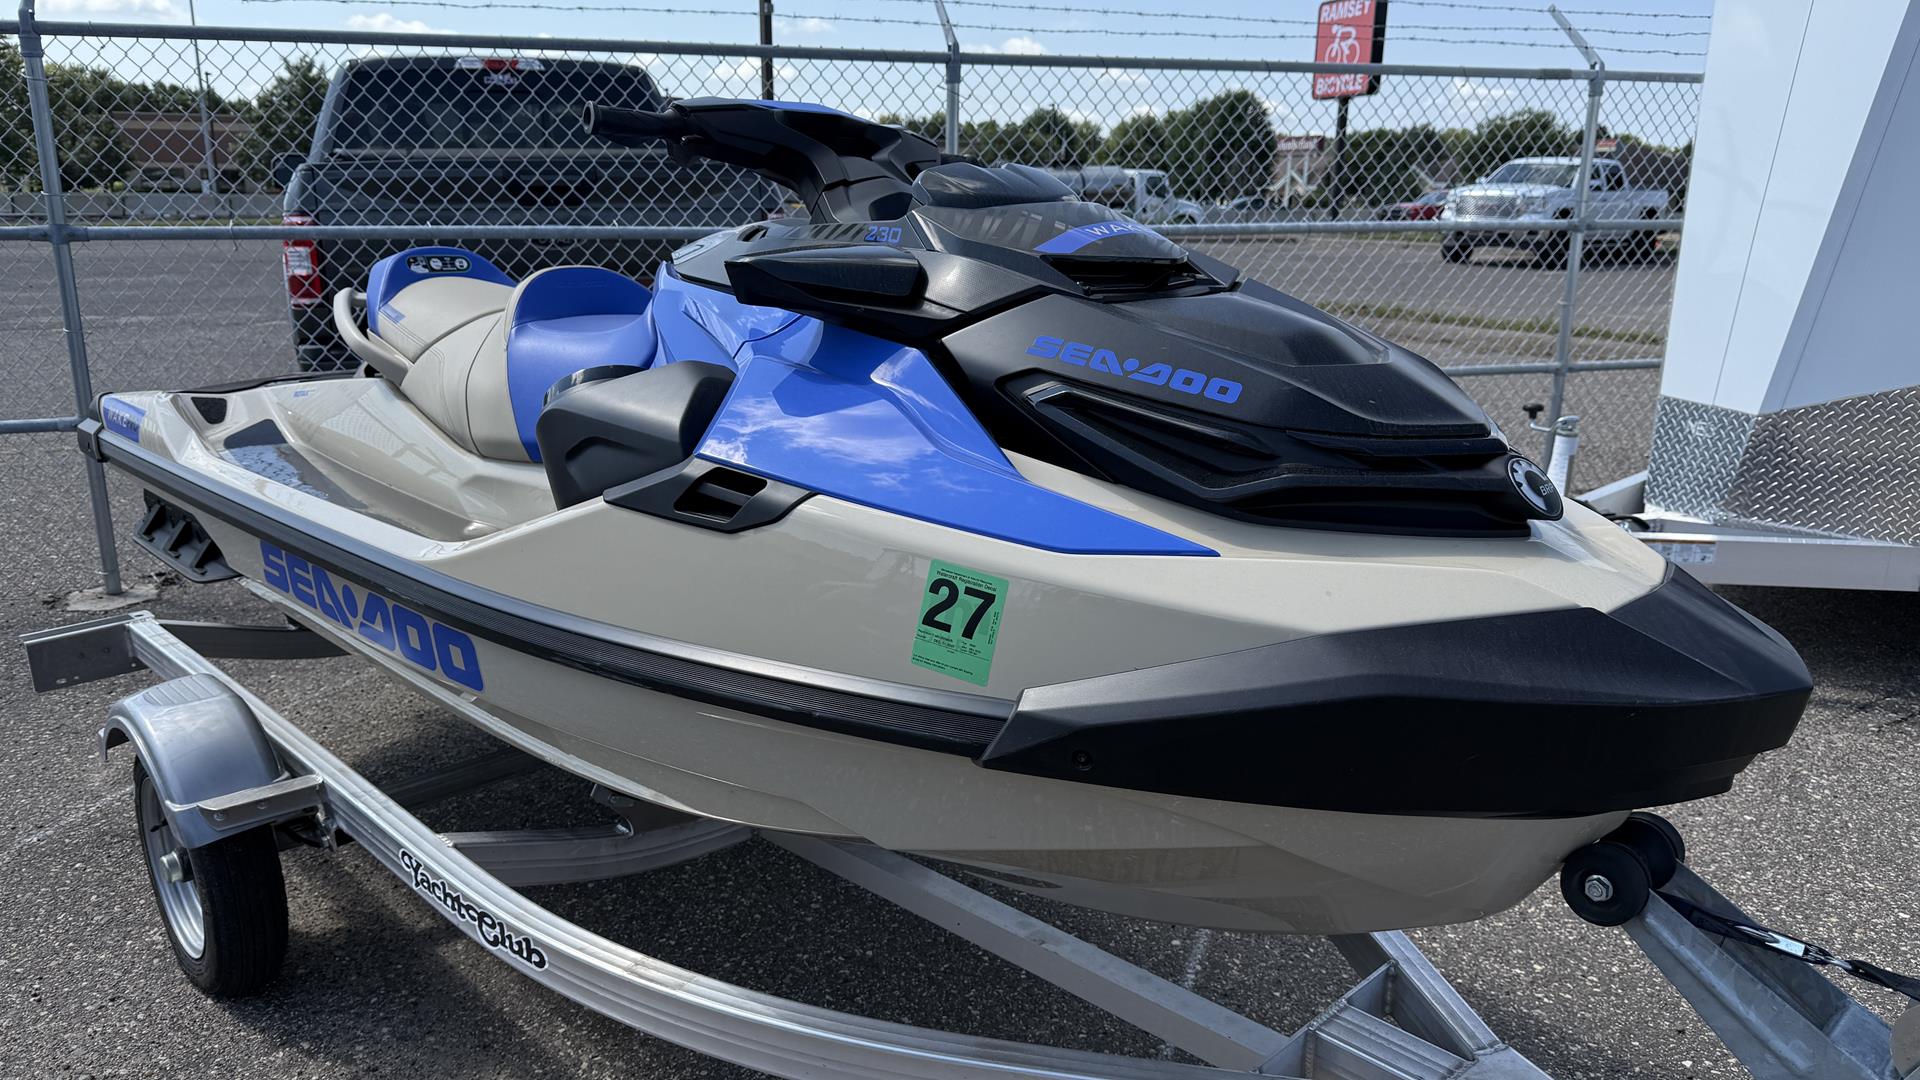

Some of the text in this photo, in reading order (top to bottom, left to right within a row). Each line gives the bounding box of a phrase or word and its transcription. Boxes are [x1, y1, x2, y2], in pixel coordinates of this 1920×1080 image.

[1320, 0, 1371, 22] RAMSEY
[1316, 74, 1364, 95] BICYCLE
[864, 225, 902, 243] 230
[1540, 482, 1554, 496] BRP
[921, 577, 996, 640] 27
